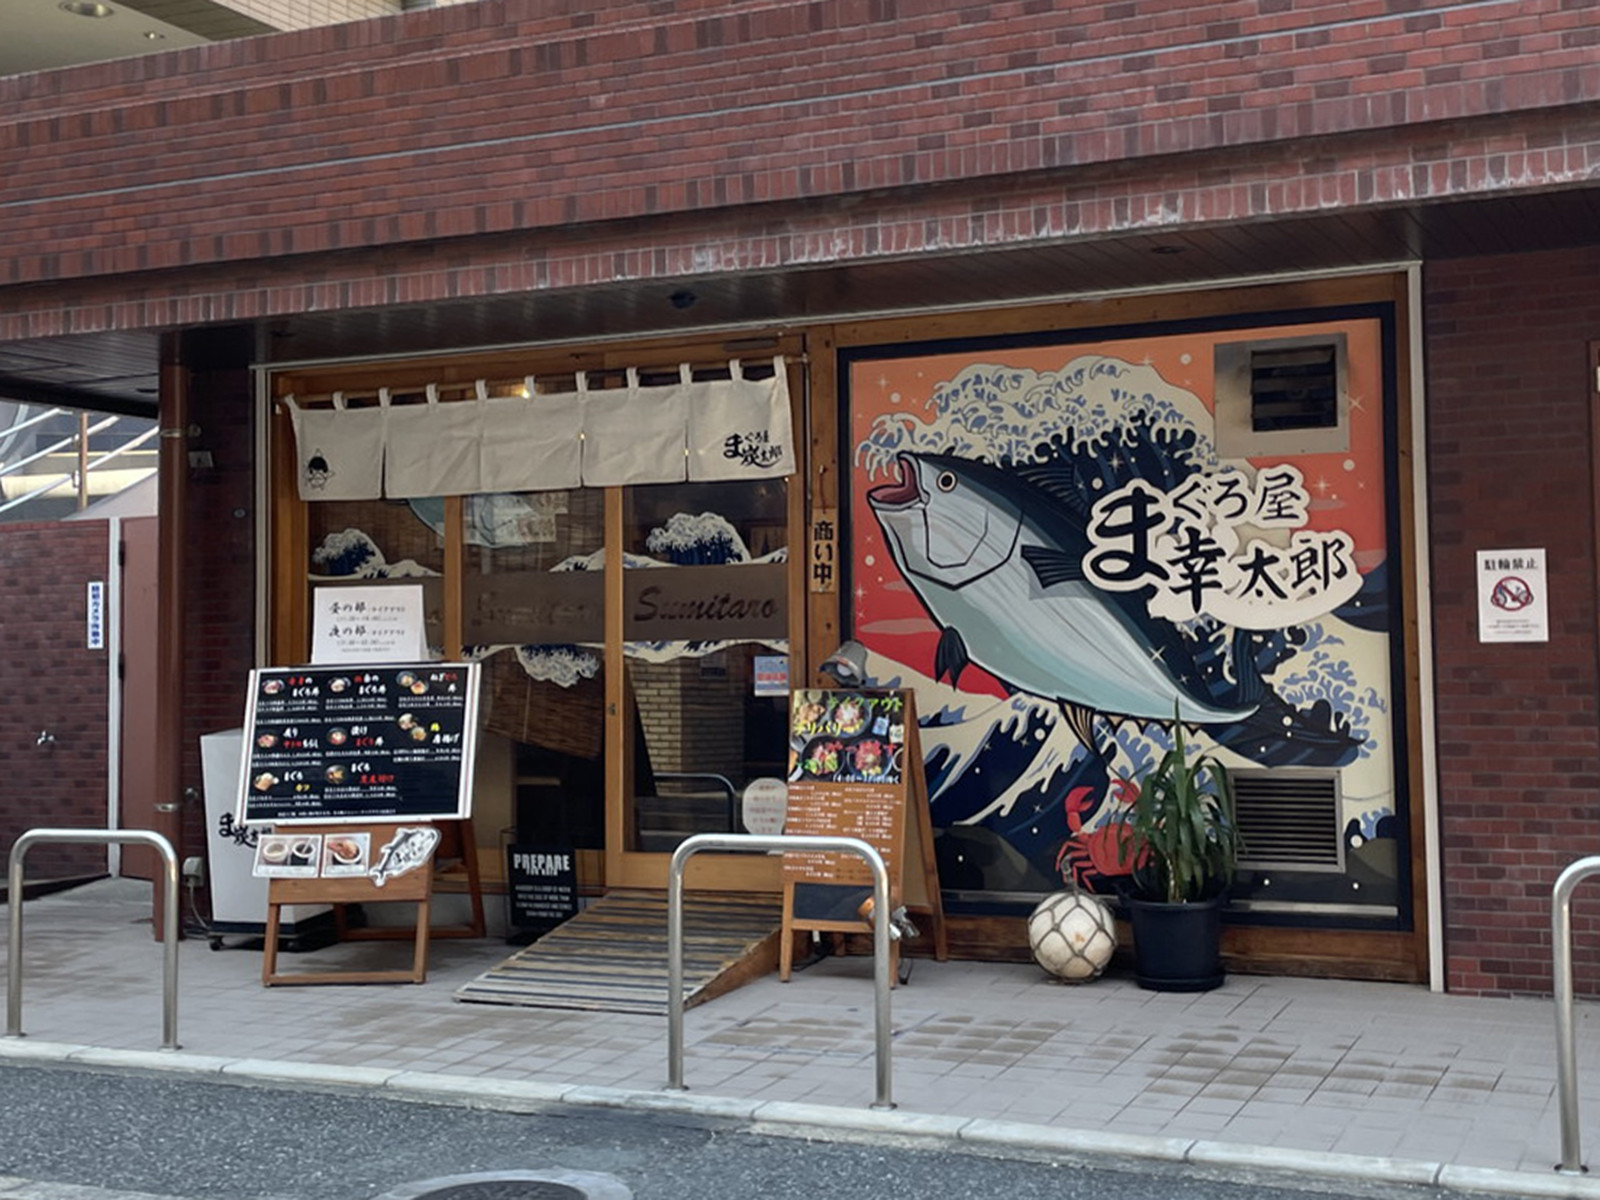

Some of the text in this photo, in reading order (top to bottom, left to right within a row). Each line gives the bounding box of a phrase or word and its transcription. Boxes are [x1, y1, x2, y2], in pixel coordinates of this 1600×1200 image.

[814, 521, 834, 584] 商い中
[1166, 526, 1348, 614] 幸太郎
[1485, 558, 1538, 570] 駐輪禁止
[634, 586, 778, 622] Sumitaro
[514, 853, 570, 871] PREPARE
